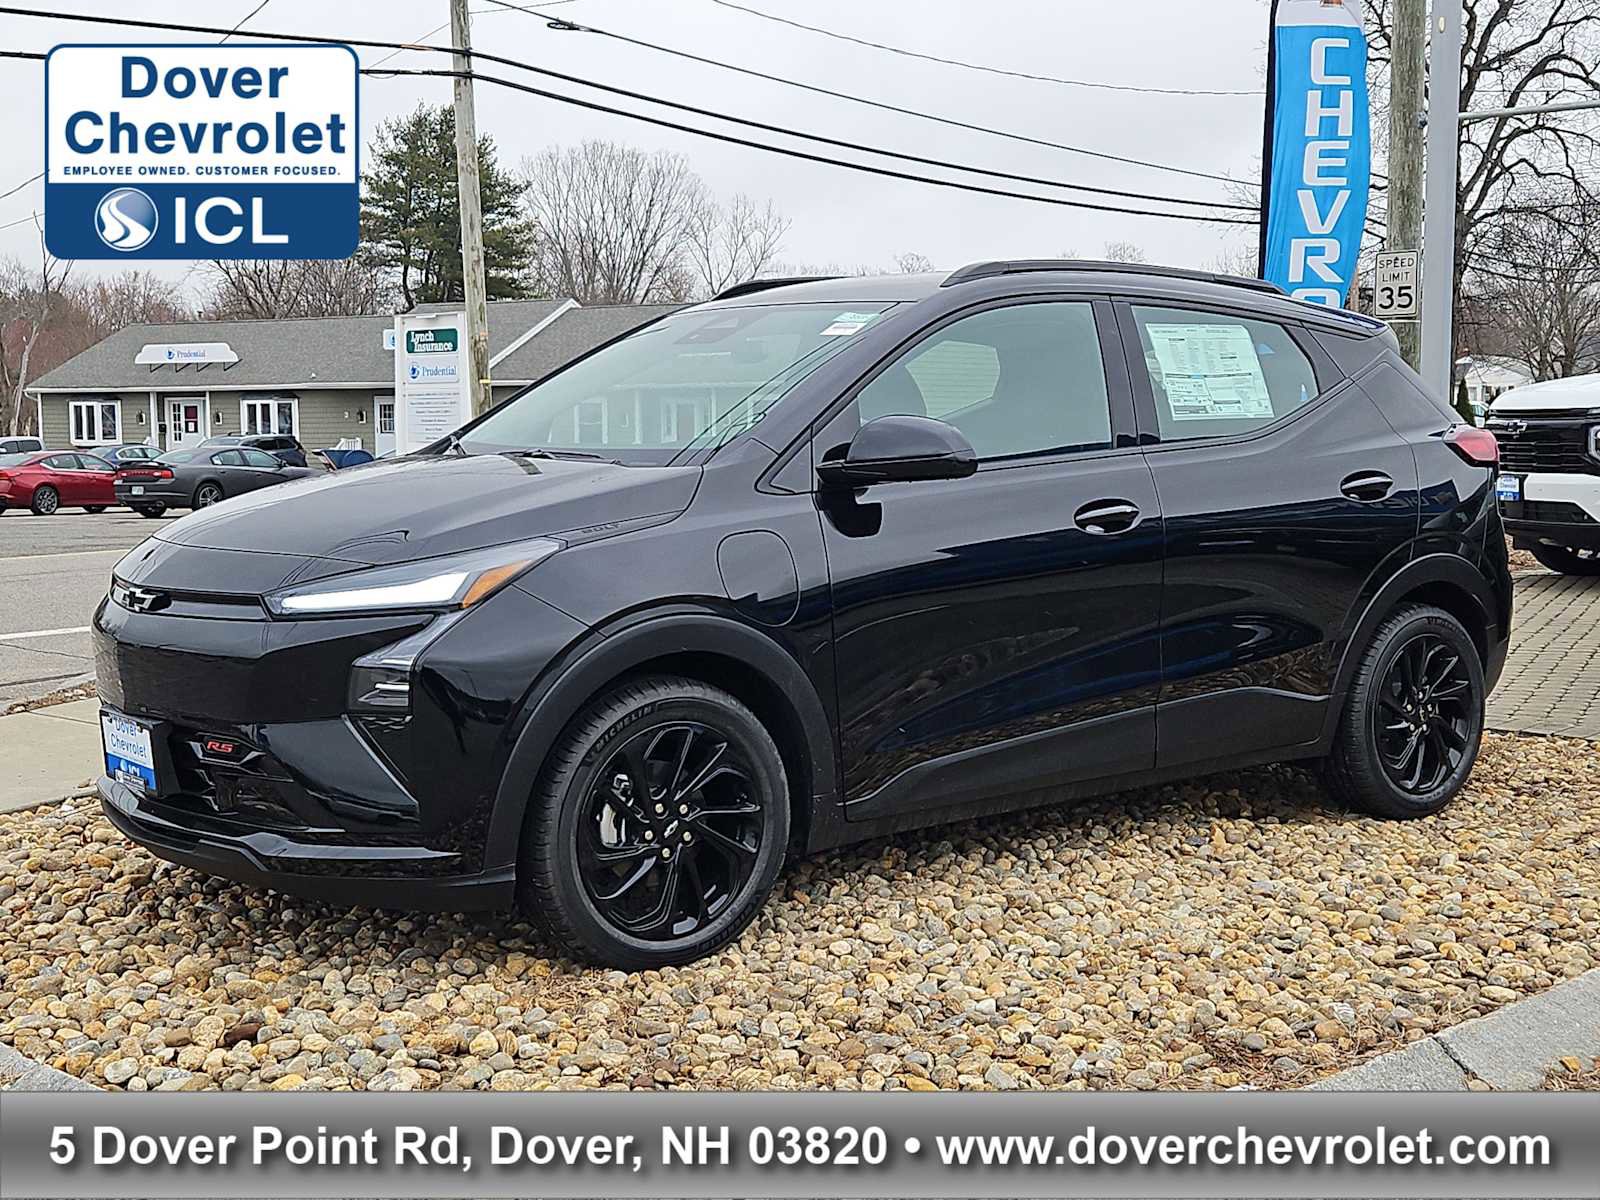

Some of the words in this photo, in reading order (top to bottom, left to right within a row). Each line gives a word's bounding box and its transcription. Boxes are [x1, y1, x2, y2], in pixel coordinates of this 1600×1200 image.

[1379, 257, 1414, 268] SPEED
[1382, 271, 1410, 282] LIMIT
[1379, 286, 1413, 309] 35
[411, 331, 434, 344] Lynch
[414, 342, 453, 352] Insurance
[422, 365, 457, 377] Prudential
[111, 733, 147, 758] Chevrolet
[207, 741, 234, 753] RS
